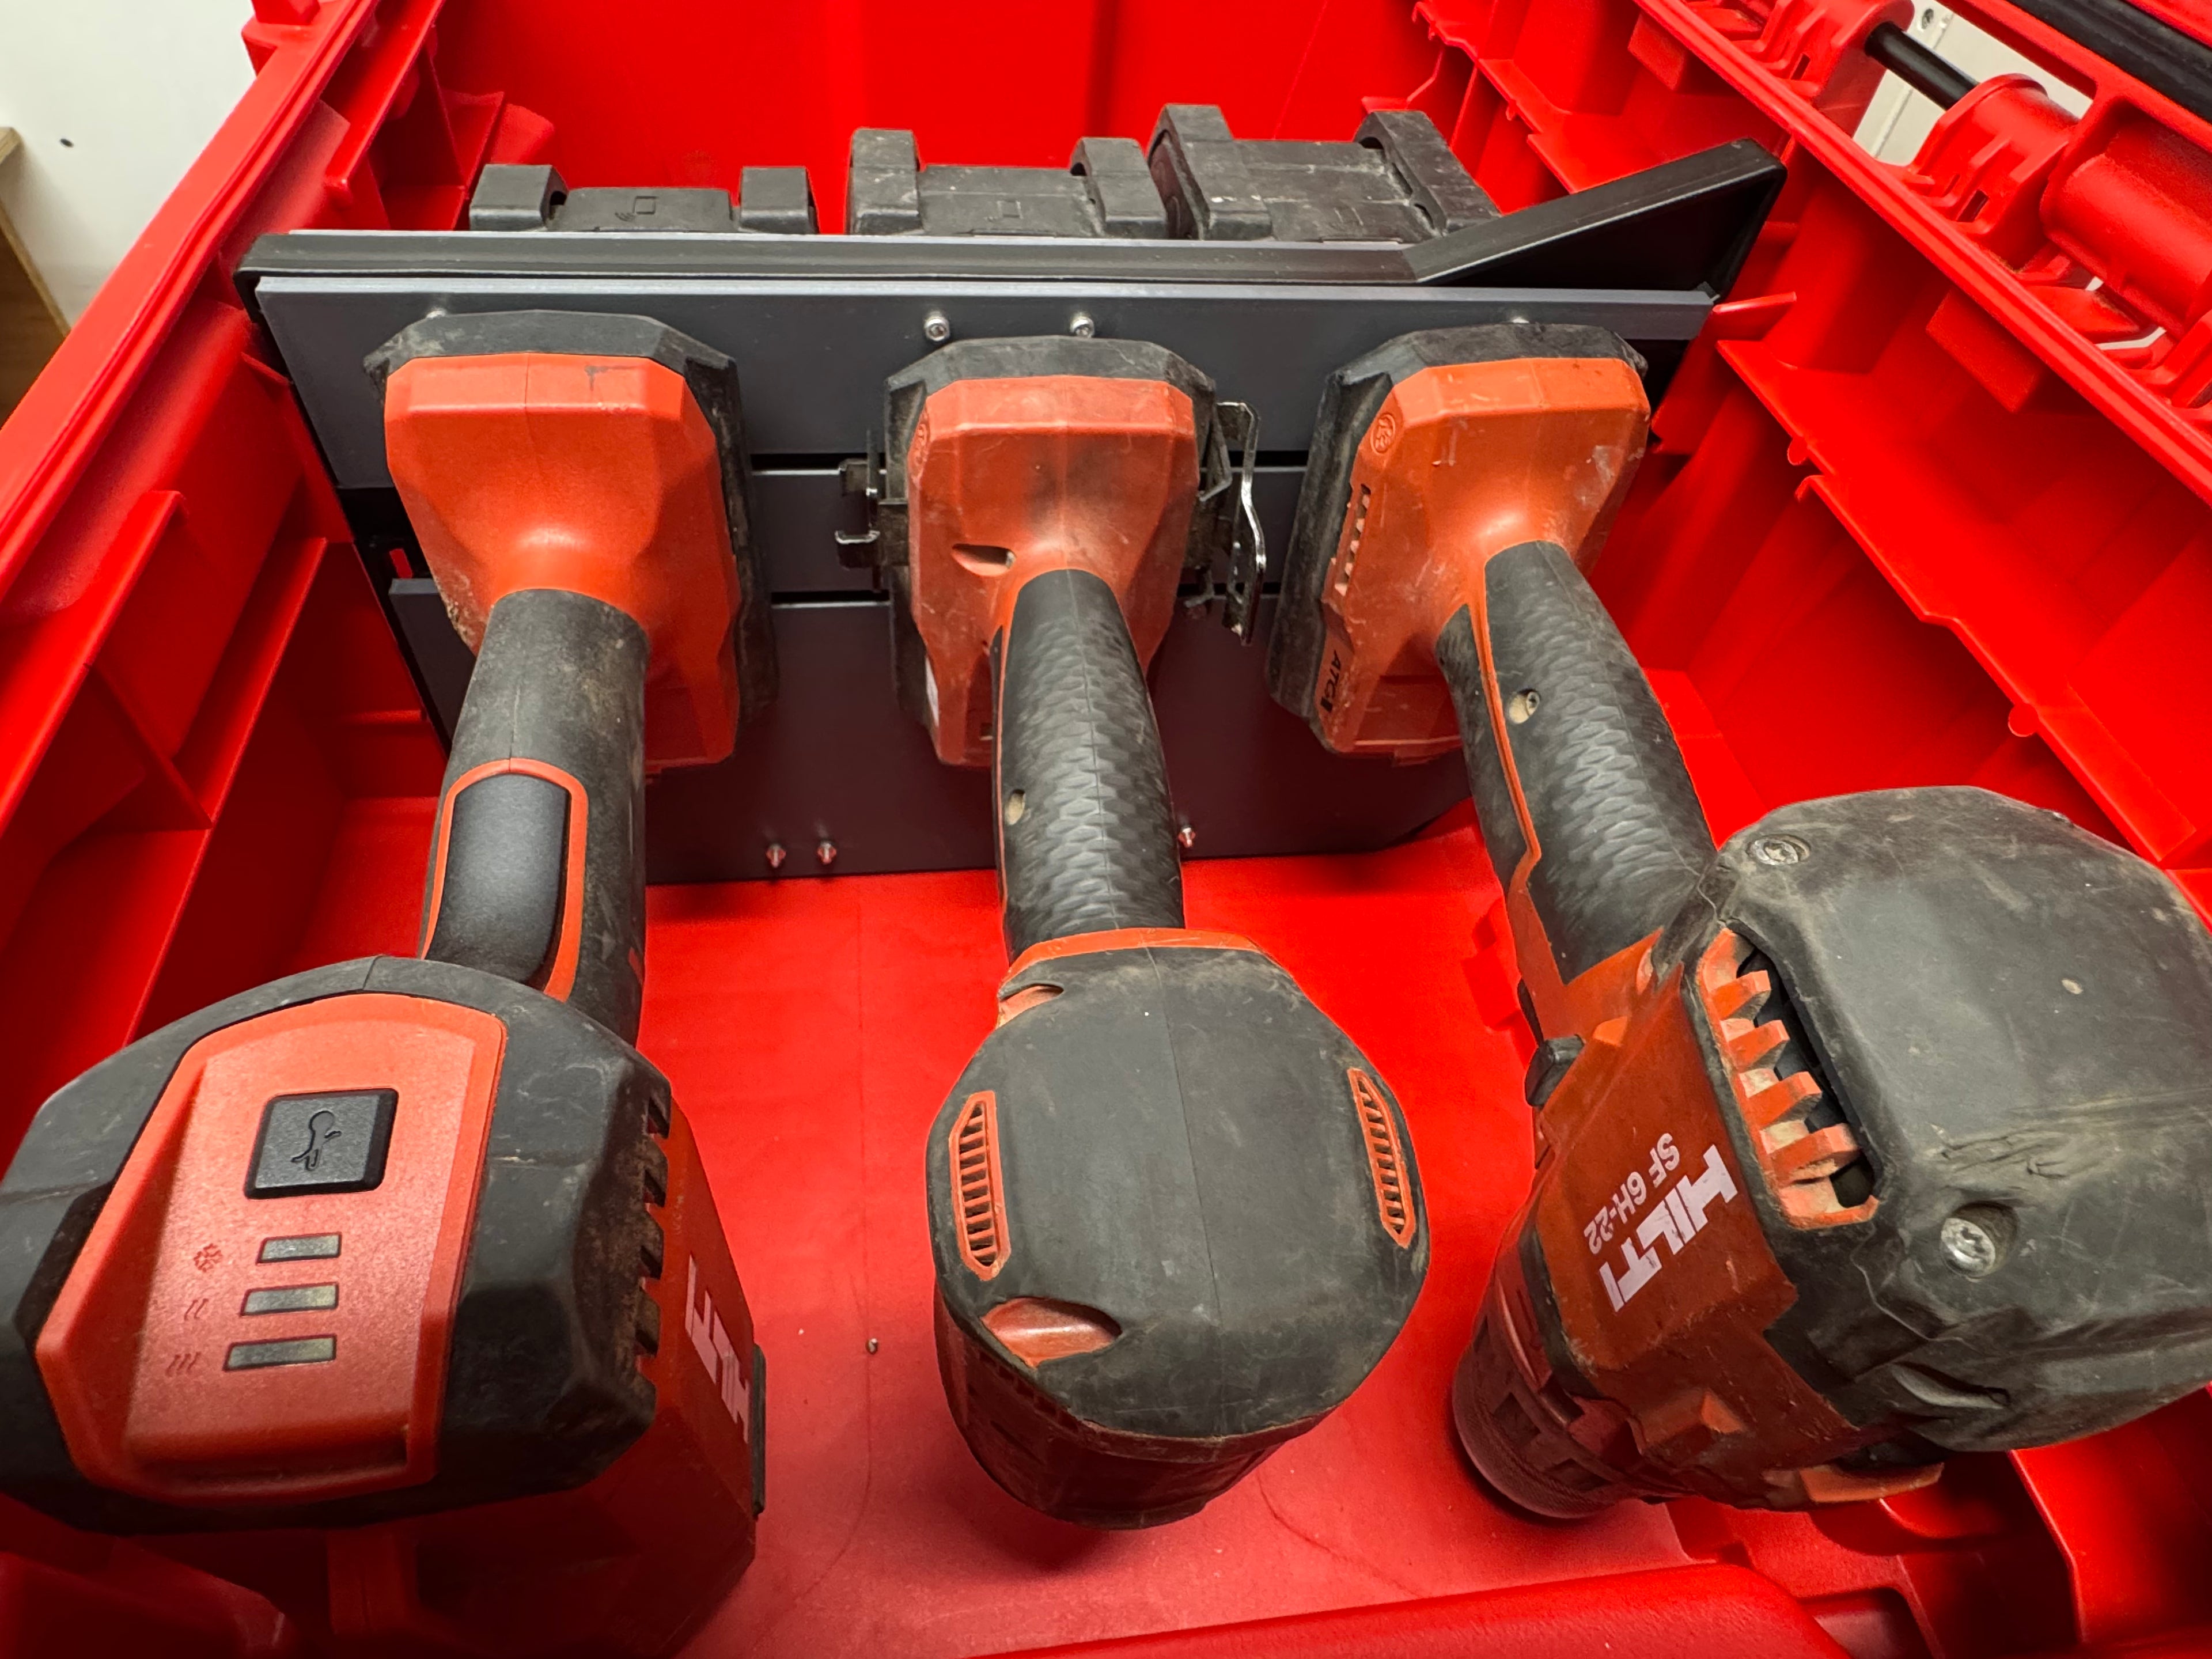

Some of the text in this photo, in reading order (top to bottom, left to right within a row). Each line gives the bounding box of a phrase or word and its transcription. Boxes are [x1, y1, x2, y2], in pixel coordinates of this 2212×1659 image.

[1584, 1133, 1680, 1254] SF 6H-22
[1599, 1144, 1738, 1313] HILTI
[685, 1253, 749, 1444] HILTI
